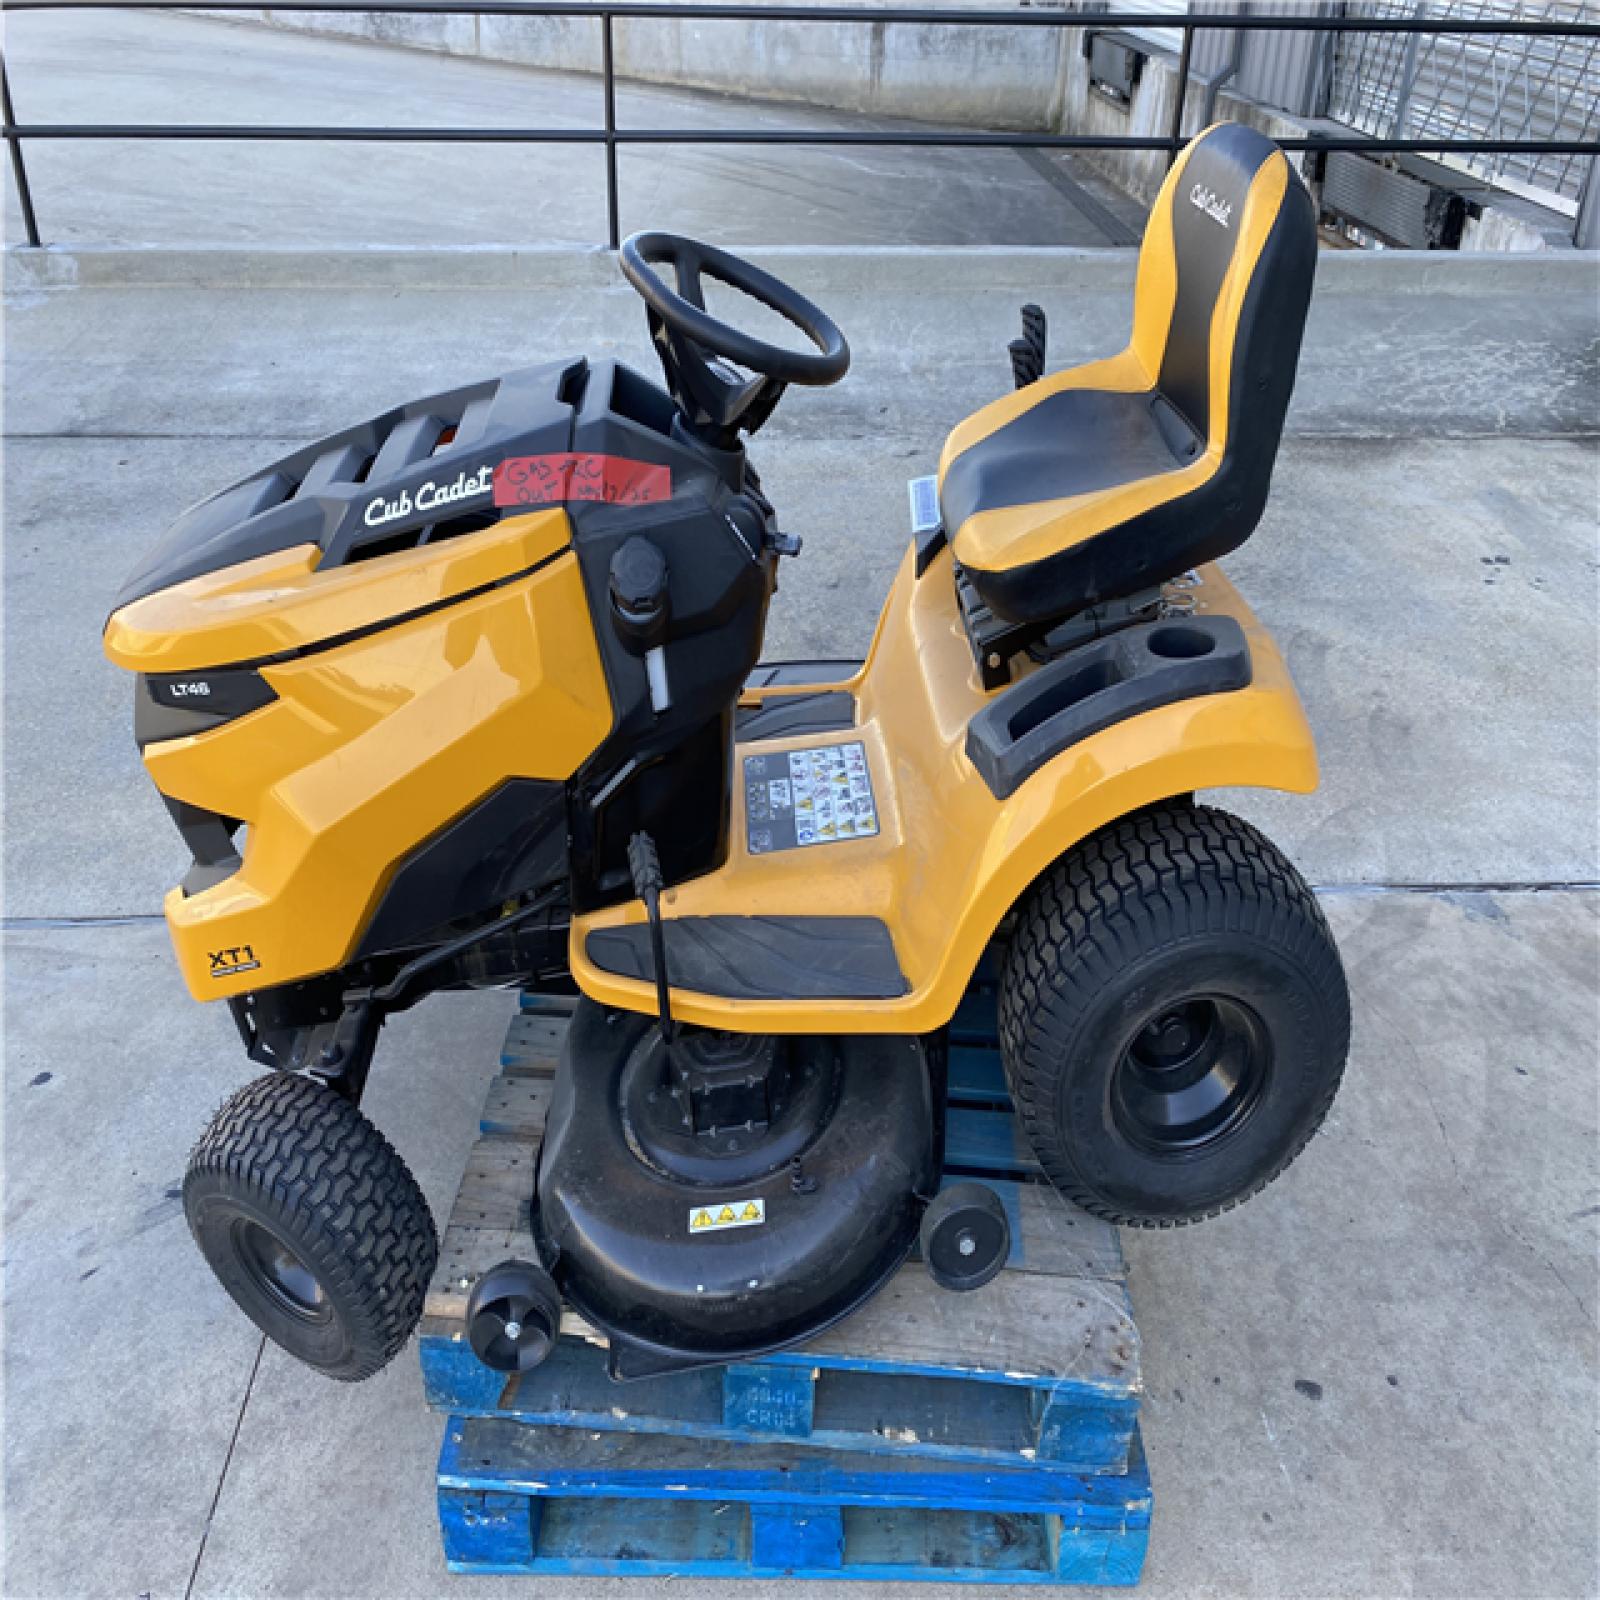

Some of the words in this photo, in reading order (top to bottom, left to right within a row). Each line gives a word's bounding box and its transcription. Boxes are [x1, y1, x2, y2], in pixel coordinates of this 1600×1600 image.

[364, 490, 412, 526] Cub
[415, 465, 493, 511] Cadet
[207, 944, 253, 968] XT1
